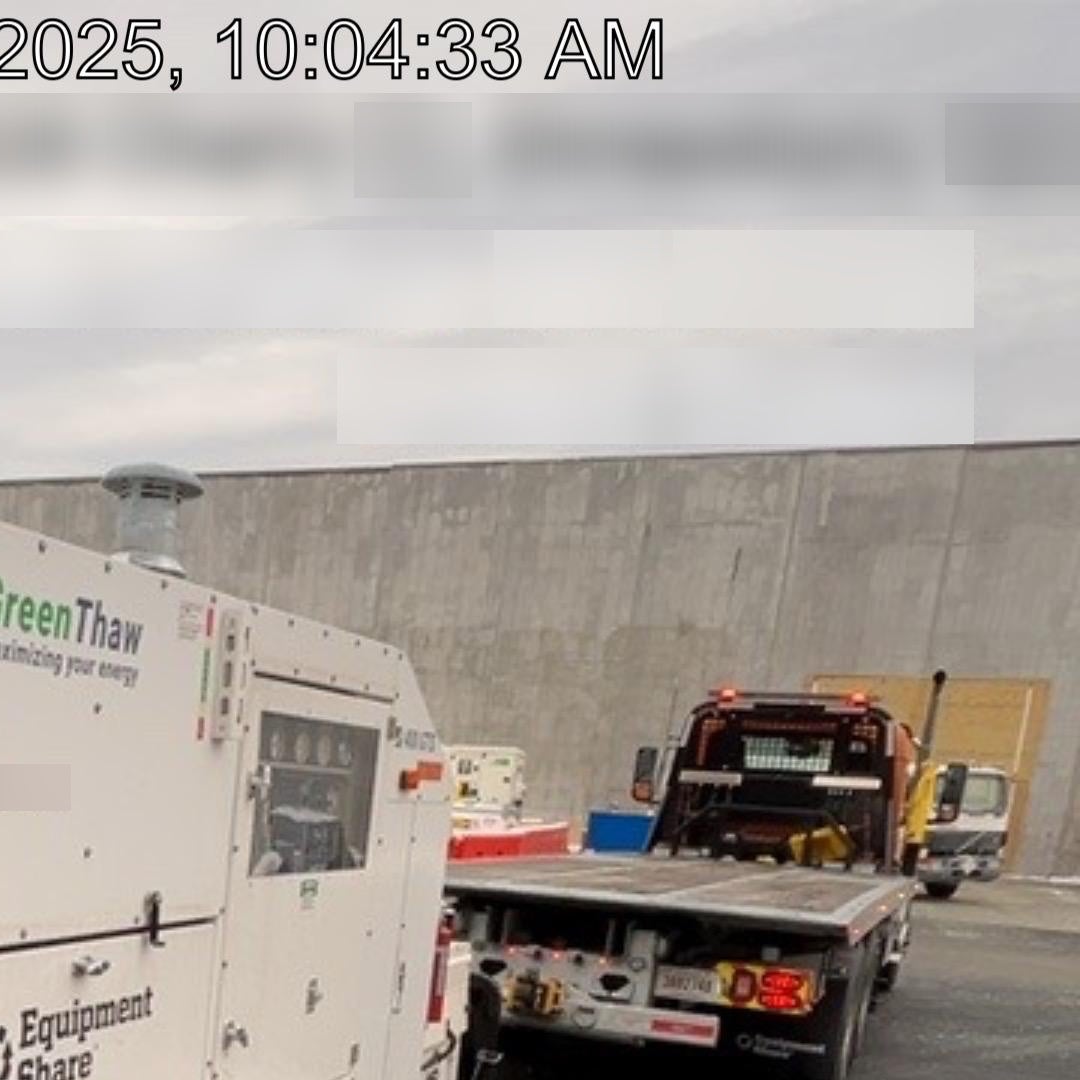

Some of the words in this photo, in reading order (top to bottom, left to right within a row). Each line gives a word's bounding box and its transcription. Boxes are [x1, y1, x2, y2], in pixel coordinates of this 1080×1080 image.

[64, 655, 96, 678] your
[98, 660, 139, 687] energy
[20, 986, 154, 1052] Equipment
